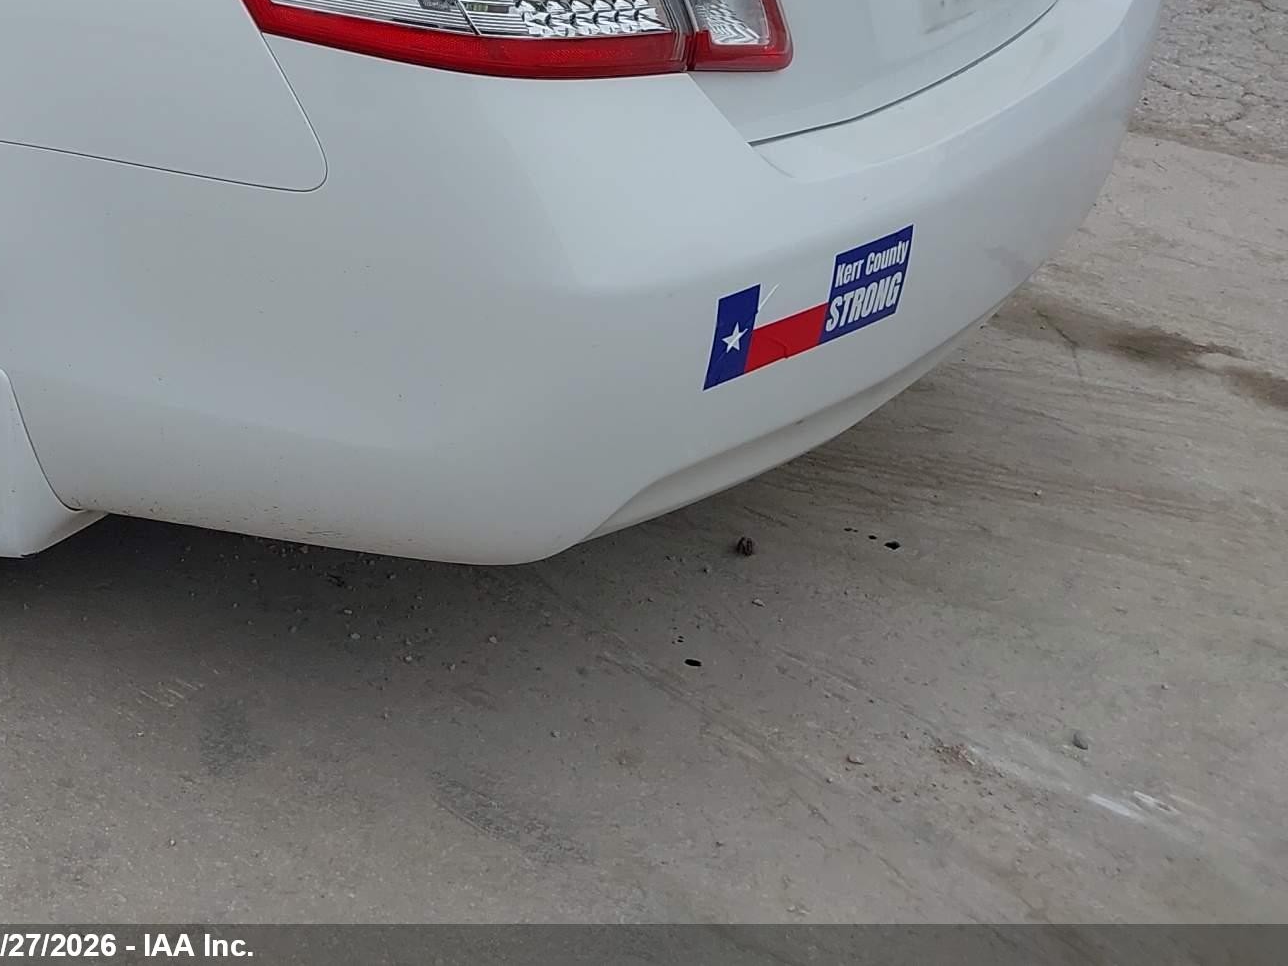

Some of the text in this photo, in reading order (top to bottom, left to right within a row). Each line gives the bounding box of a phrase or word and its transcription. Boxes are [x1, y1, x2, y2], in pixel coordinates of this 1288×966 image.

[834, 239, 909, 288] Kerr County
[825, 271, 903, 332] STRONG
